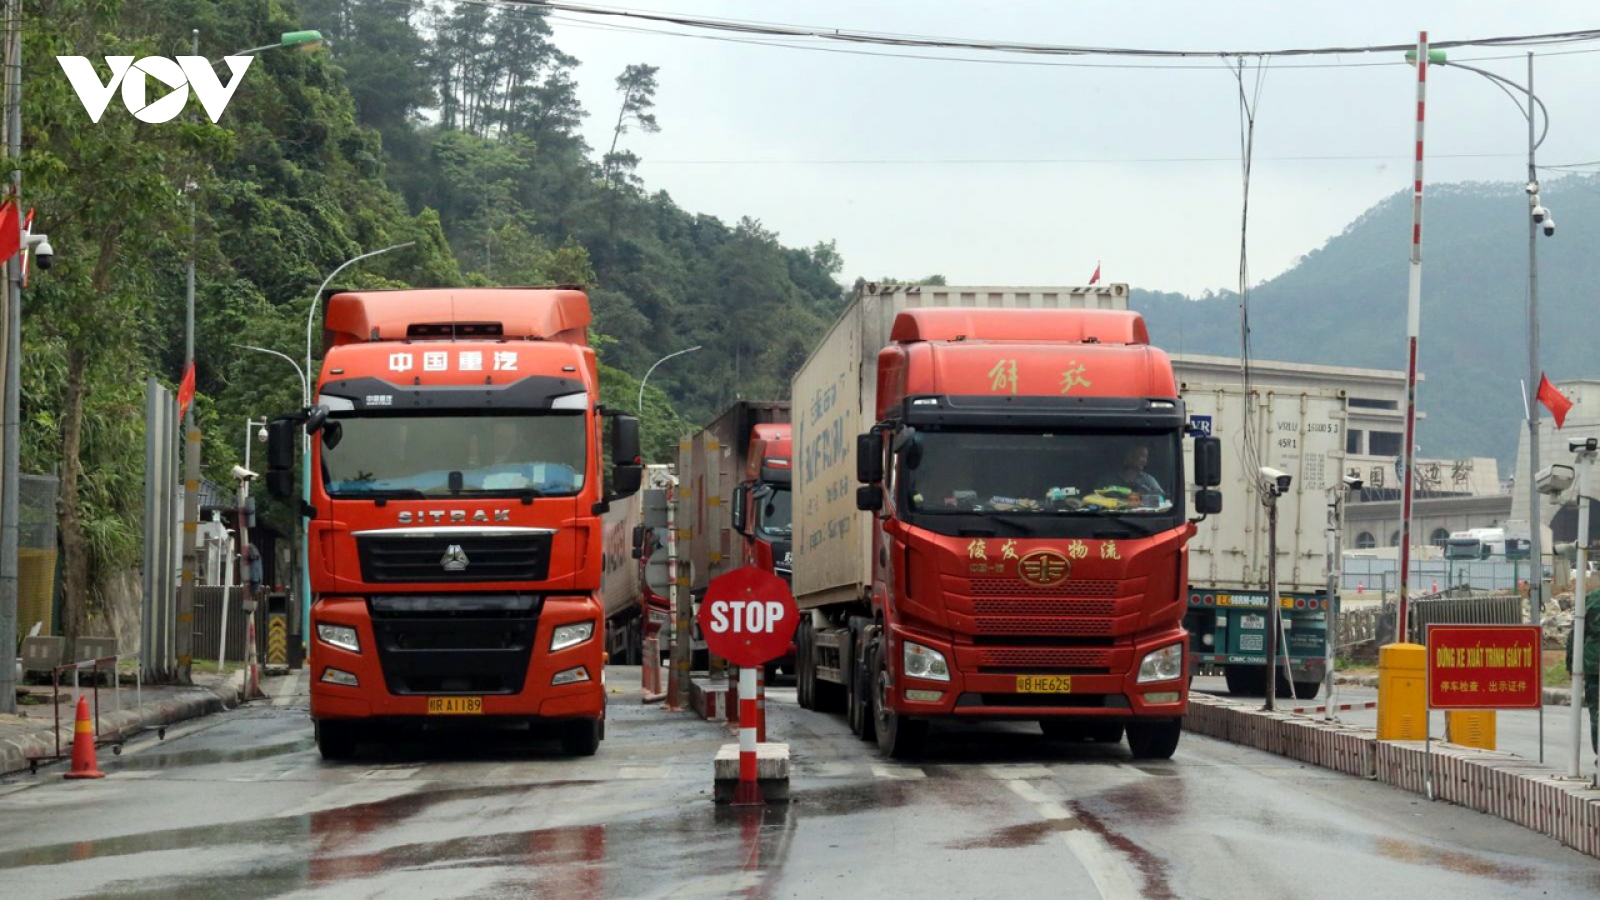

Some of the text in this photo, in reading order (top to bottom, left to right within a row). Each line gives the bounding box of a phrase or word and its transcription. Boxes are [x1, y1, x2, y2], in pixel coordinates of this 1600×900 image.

[389, 352, 518, 372] 中国重汽
[1278, 438, 1296, 449] 45R1
[398, 509, 510, 523] SITRAK
[710, 600, 785, 633] STOP
[1456, 648, 1465, 668] XE
